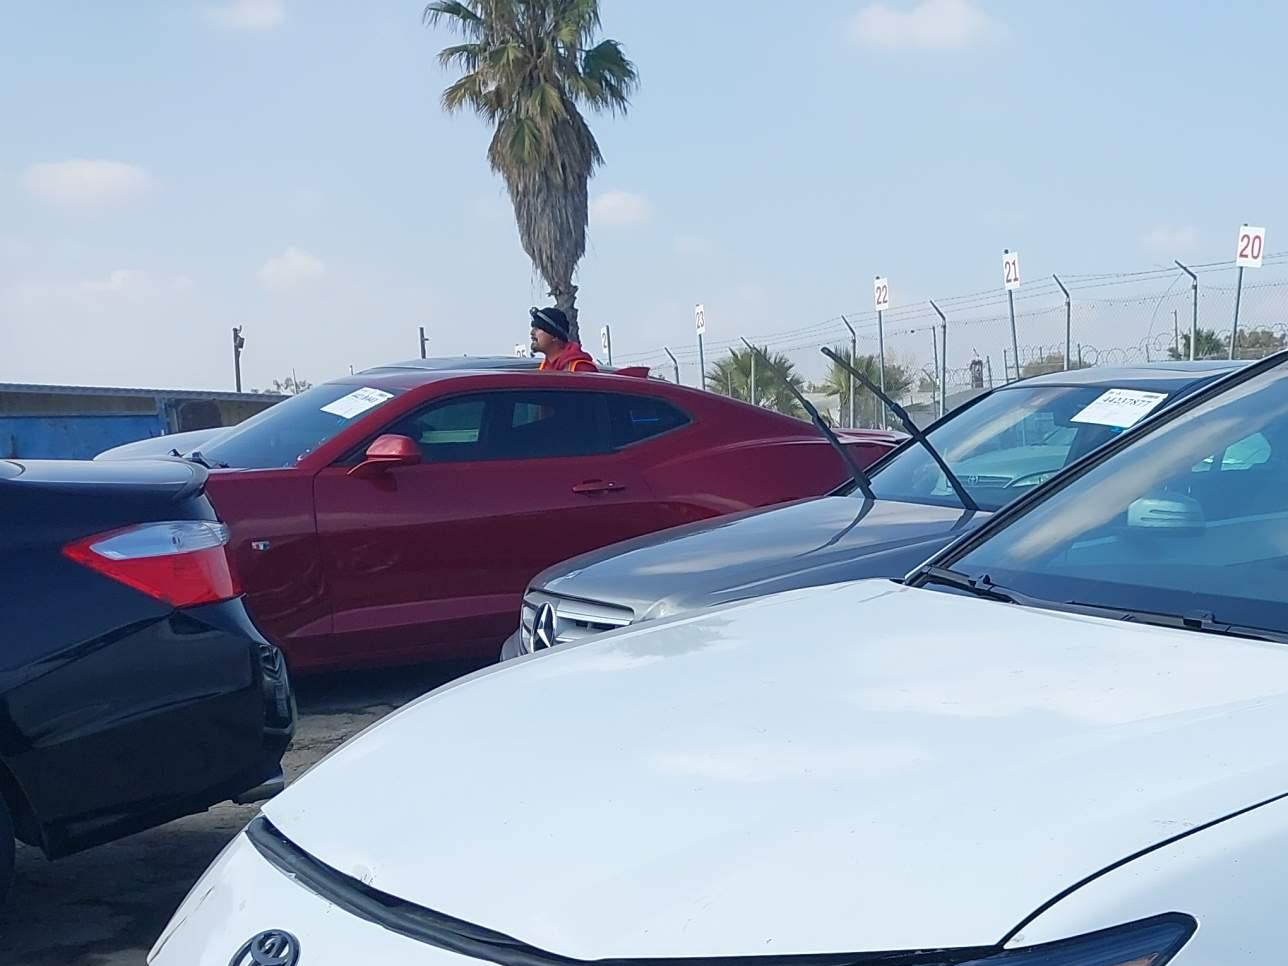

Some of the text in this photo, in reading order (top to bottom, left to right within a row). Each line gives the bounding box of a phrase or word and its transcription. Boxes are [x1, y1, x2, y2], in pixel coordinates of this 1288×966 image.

[1239, 233, 1262, 260] 20
[1004, 260, 1019, 283] 21
[876, 285, 888, 305] 22
[695, 310, 705, 330] 23
